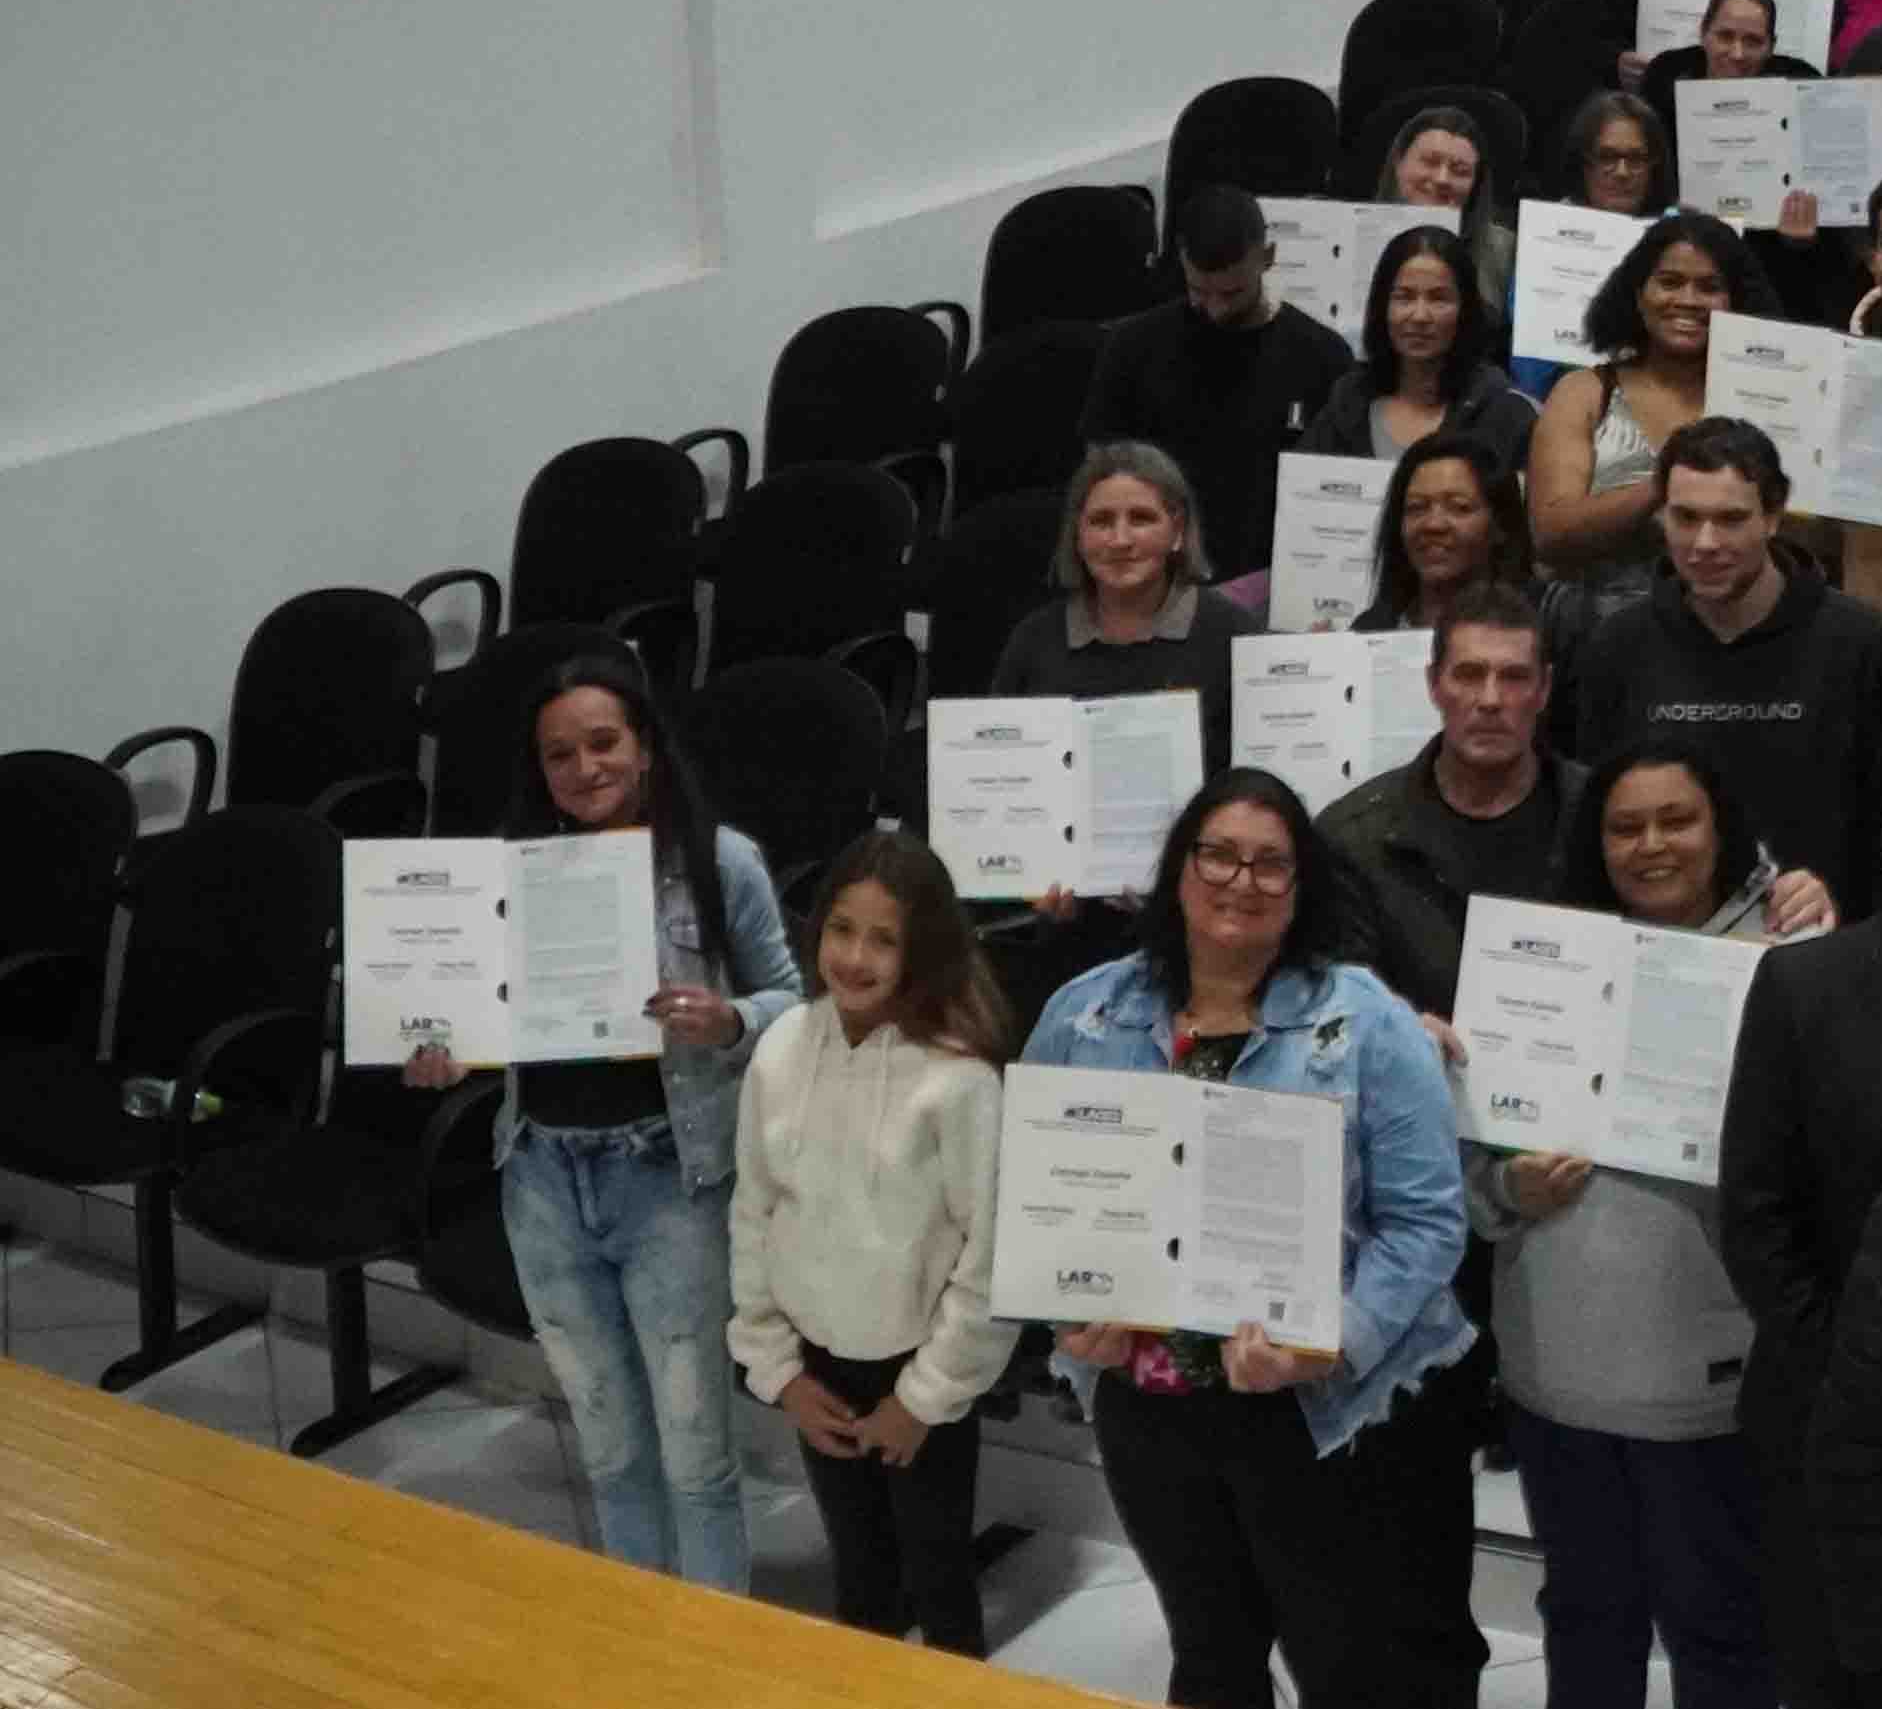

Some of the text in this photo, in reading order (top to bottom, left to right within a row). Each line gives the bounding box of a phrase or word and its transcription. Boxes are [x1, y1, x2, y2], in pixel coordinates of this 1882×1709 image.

[1647, 701, 1805, 723] UNDERGROUND
[1491, 1093, 1522, 1109] LAR
[1058, 1271, 1093, 1286] LAR
